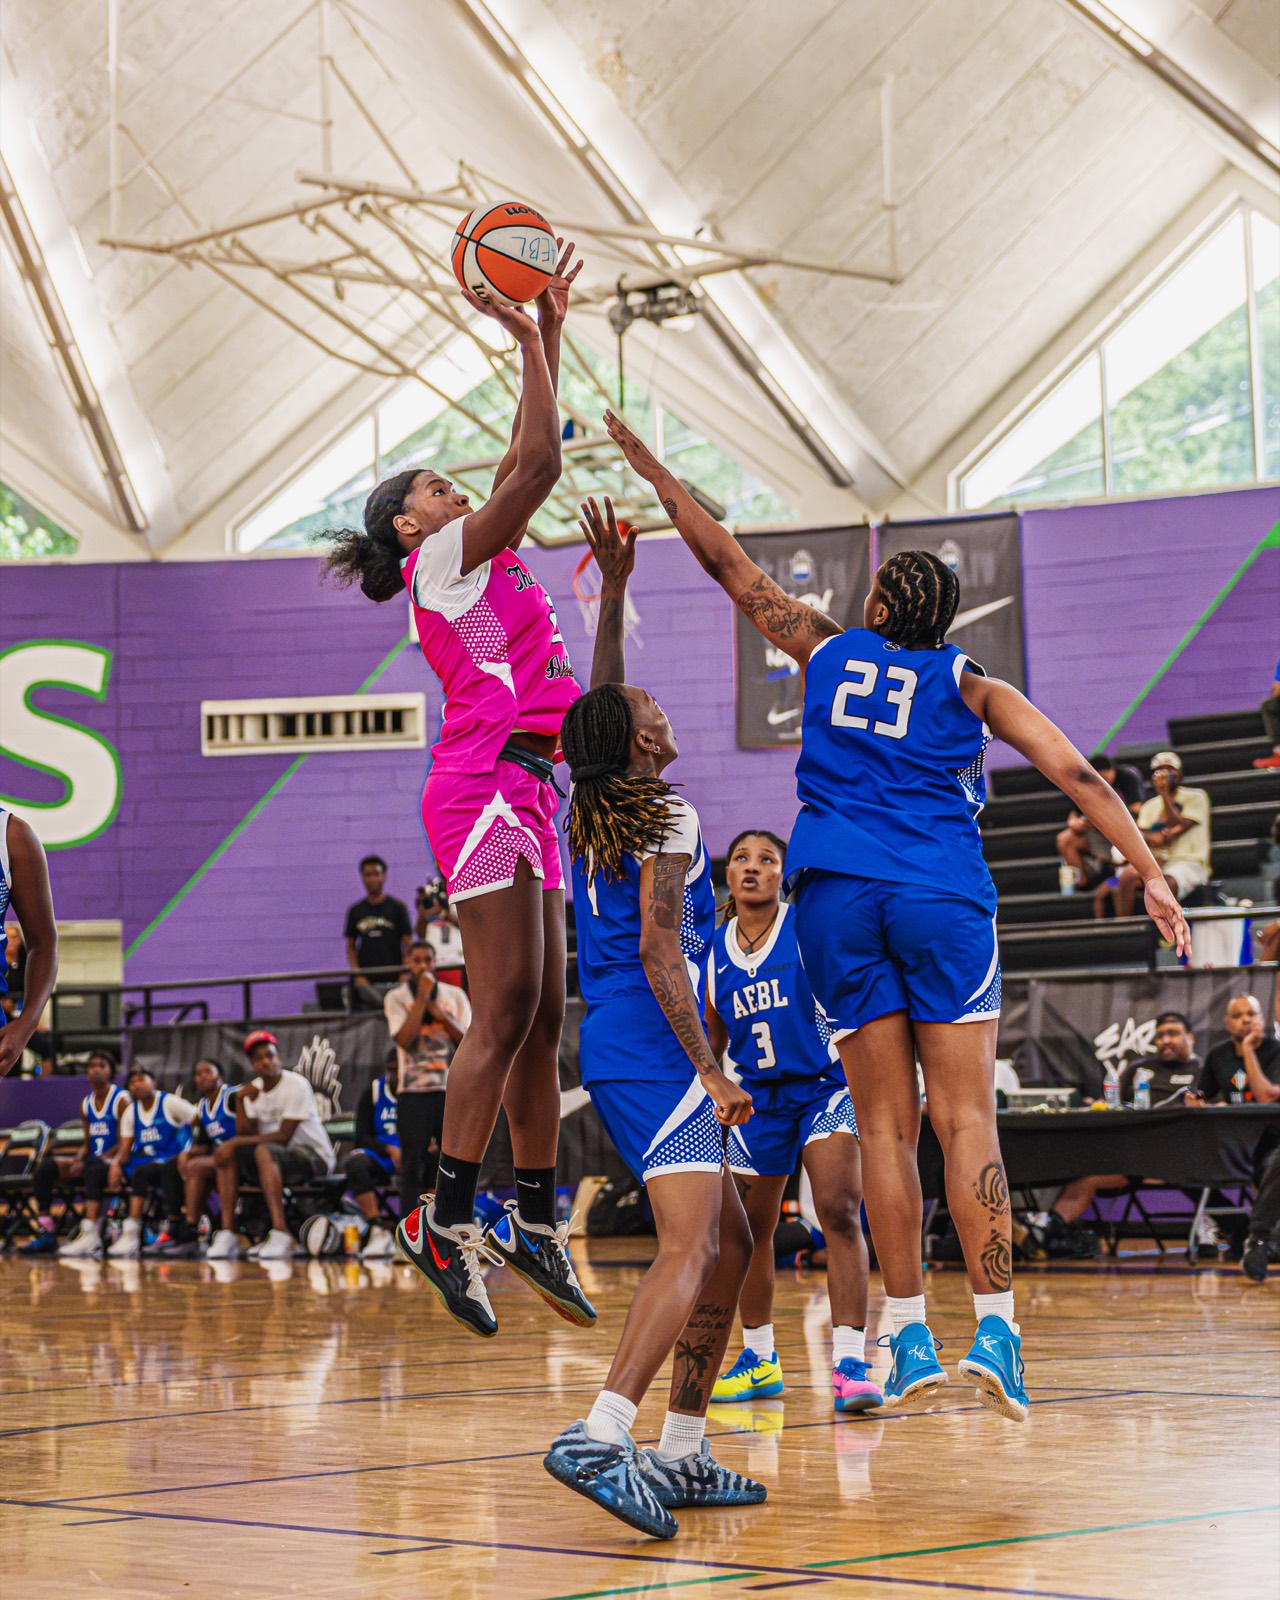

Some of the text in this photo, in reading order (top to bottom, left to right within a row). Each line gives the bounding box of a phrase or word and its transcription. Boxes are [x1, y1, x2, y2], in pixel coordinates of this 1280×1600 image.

[830, 659, 918, 739] 23
[733, 978, 789, 1020] AEBL
[751, 1020, 777, 1070] 3
